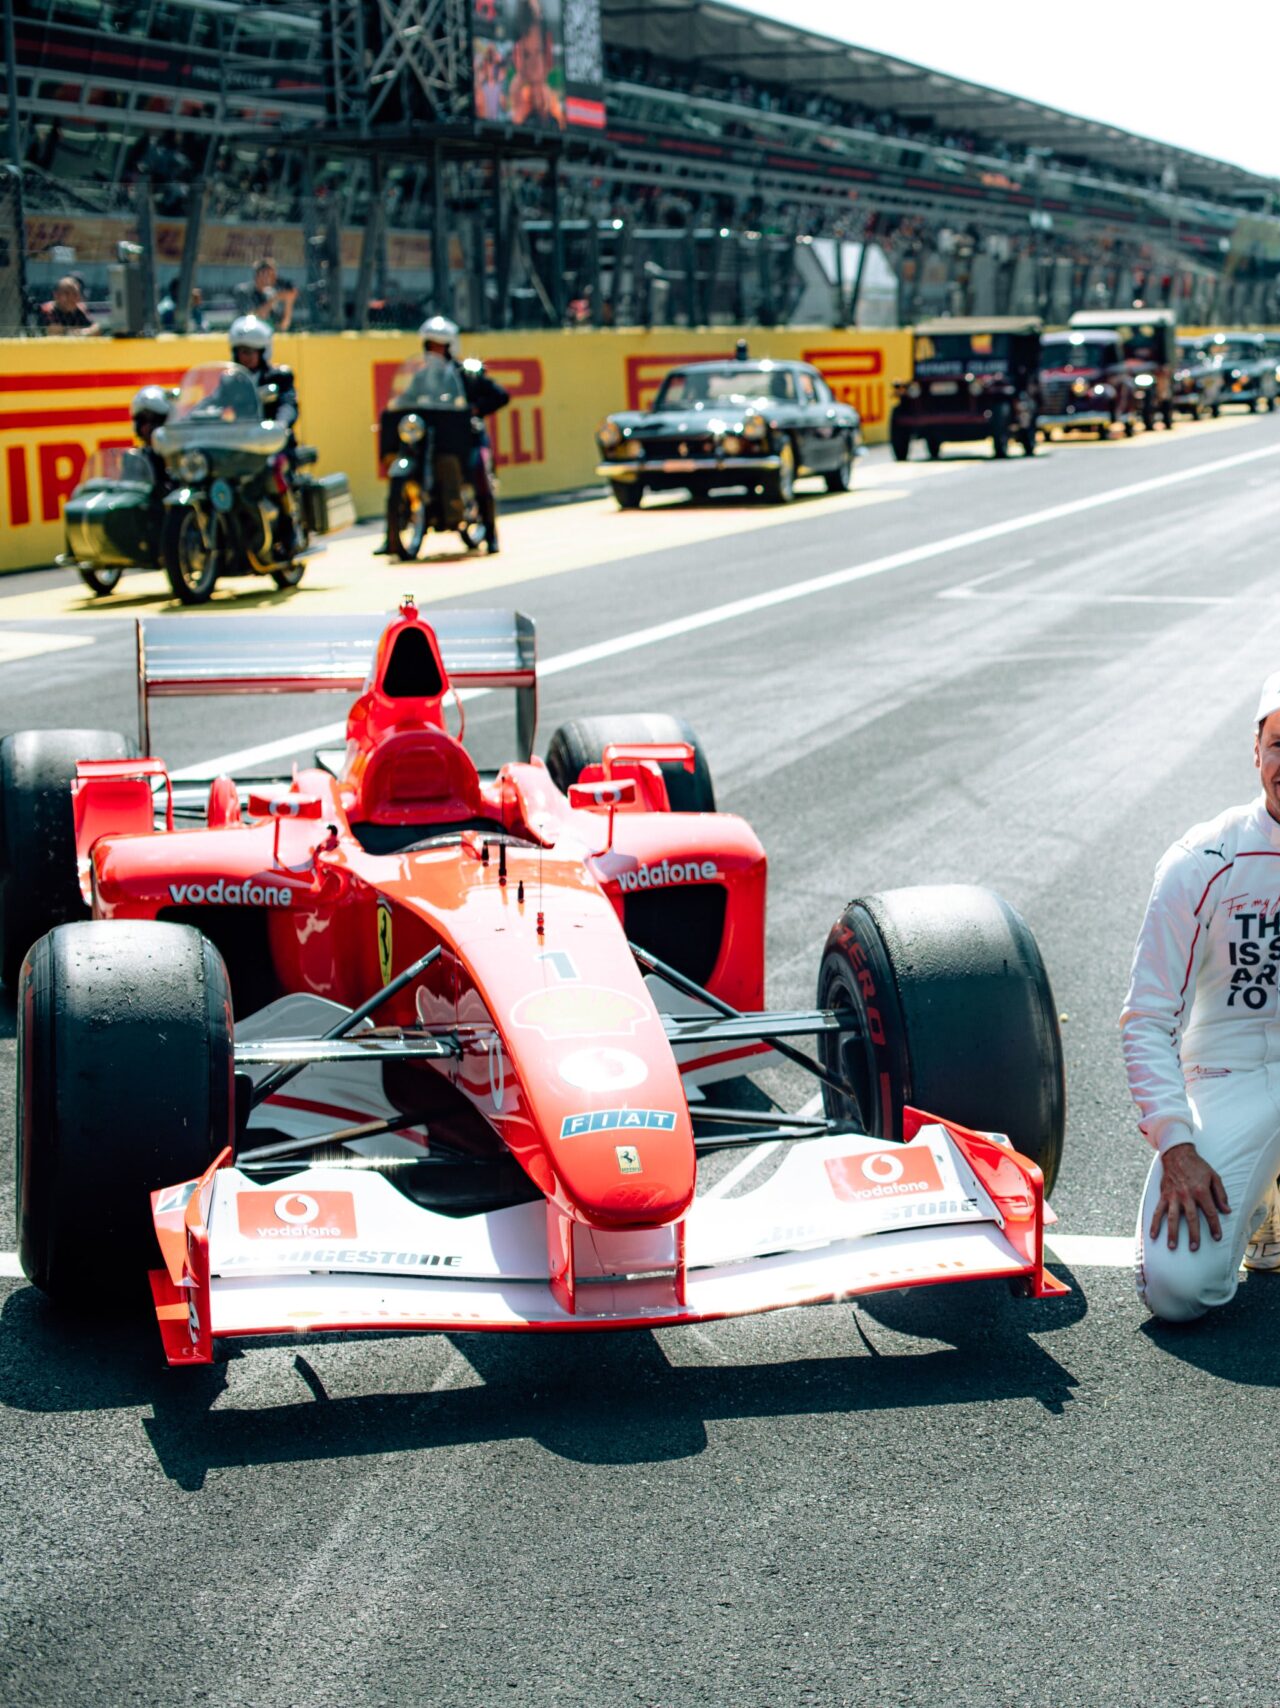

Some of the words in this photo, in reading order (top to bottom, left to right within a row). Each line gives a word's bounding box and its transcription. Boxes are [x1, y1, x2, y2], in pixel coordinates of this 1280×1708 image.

[616, 858, 718, 892] vodafone
[168, 879, 293, 907] vodafone
[535, 951, 581, 980] 1
[1229, 941, 1261, 966] IS
[1227, 984, 1268, 1010] TO
[570, 1112, 669, 1133] FIAT
[852, 1180, 929, 1200] vodafone
[256, 1224, 341, 1238] vodafone
